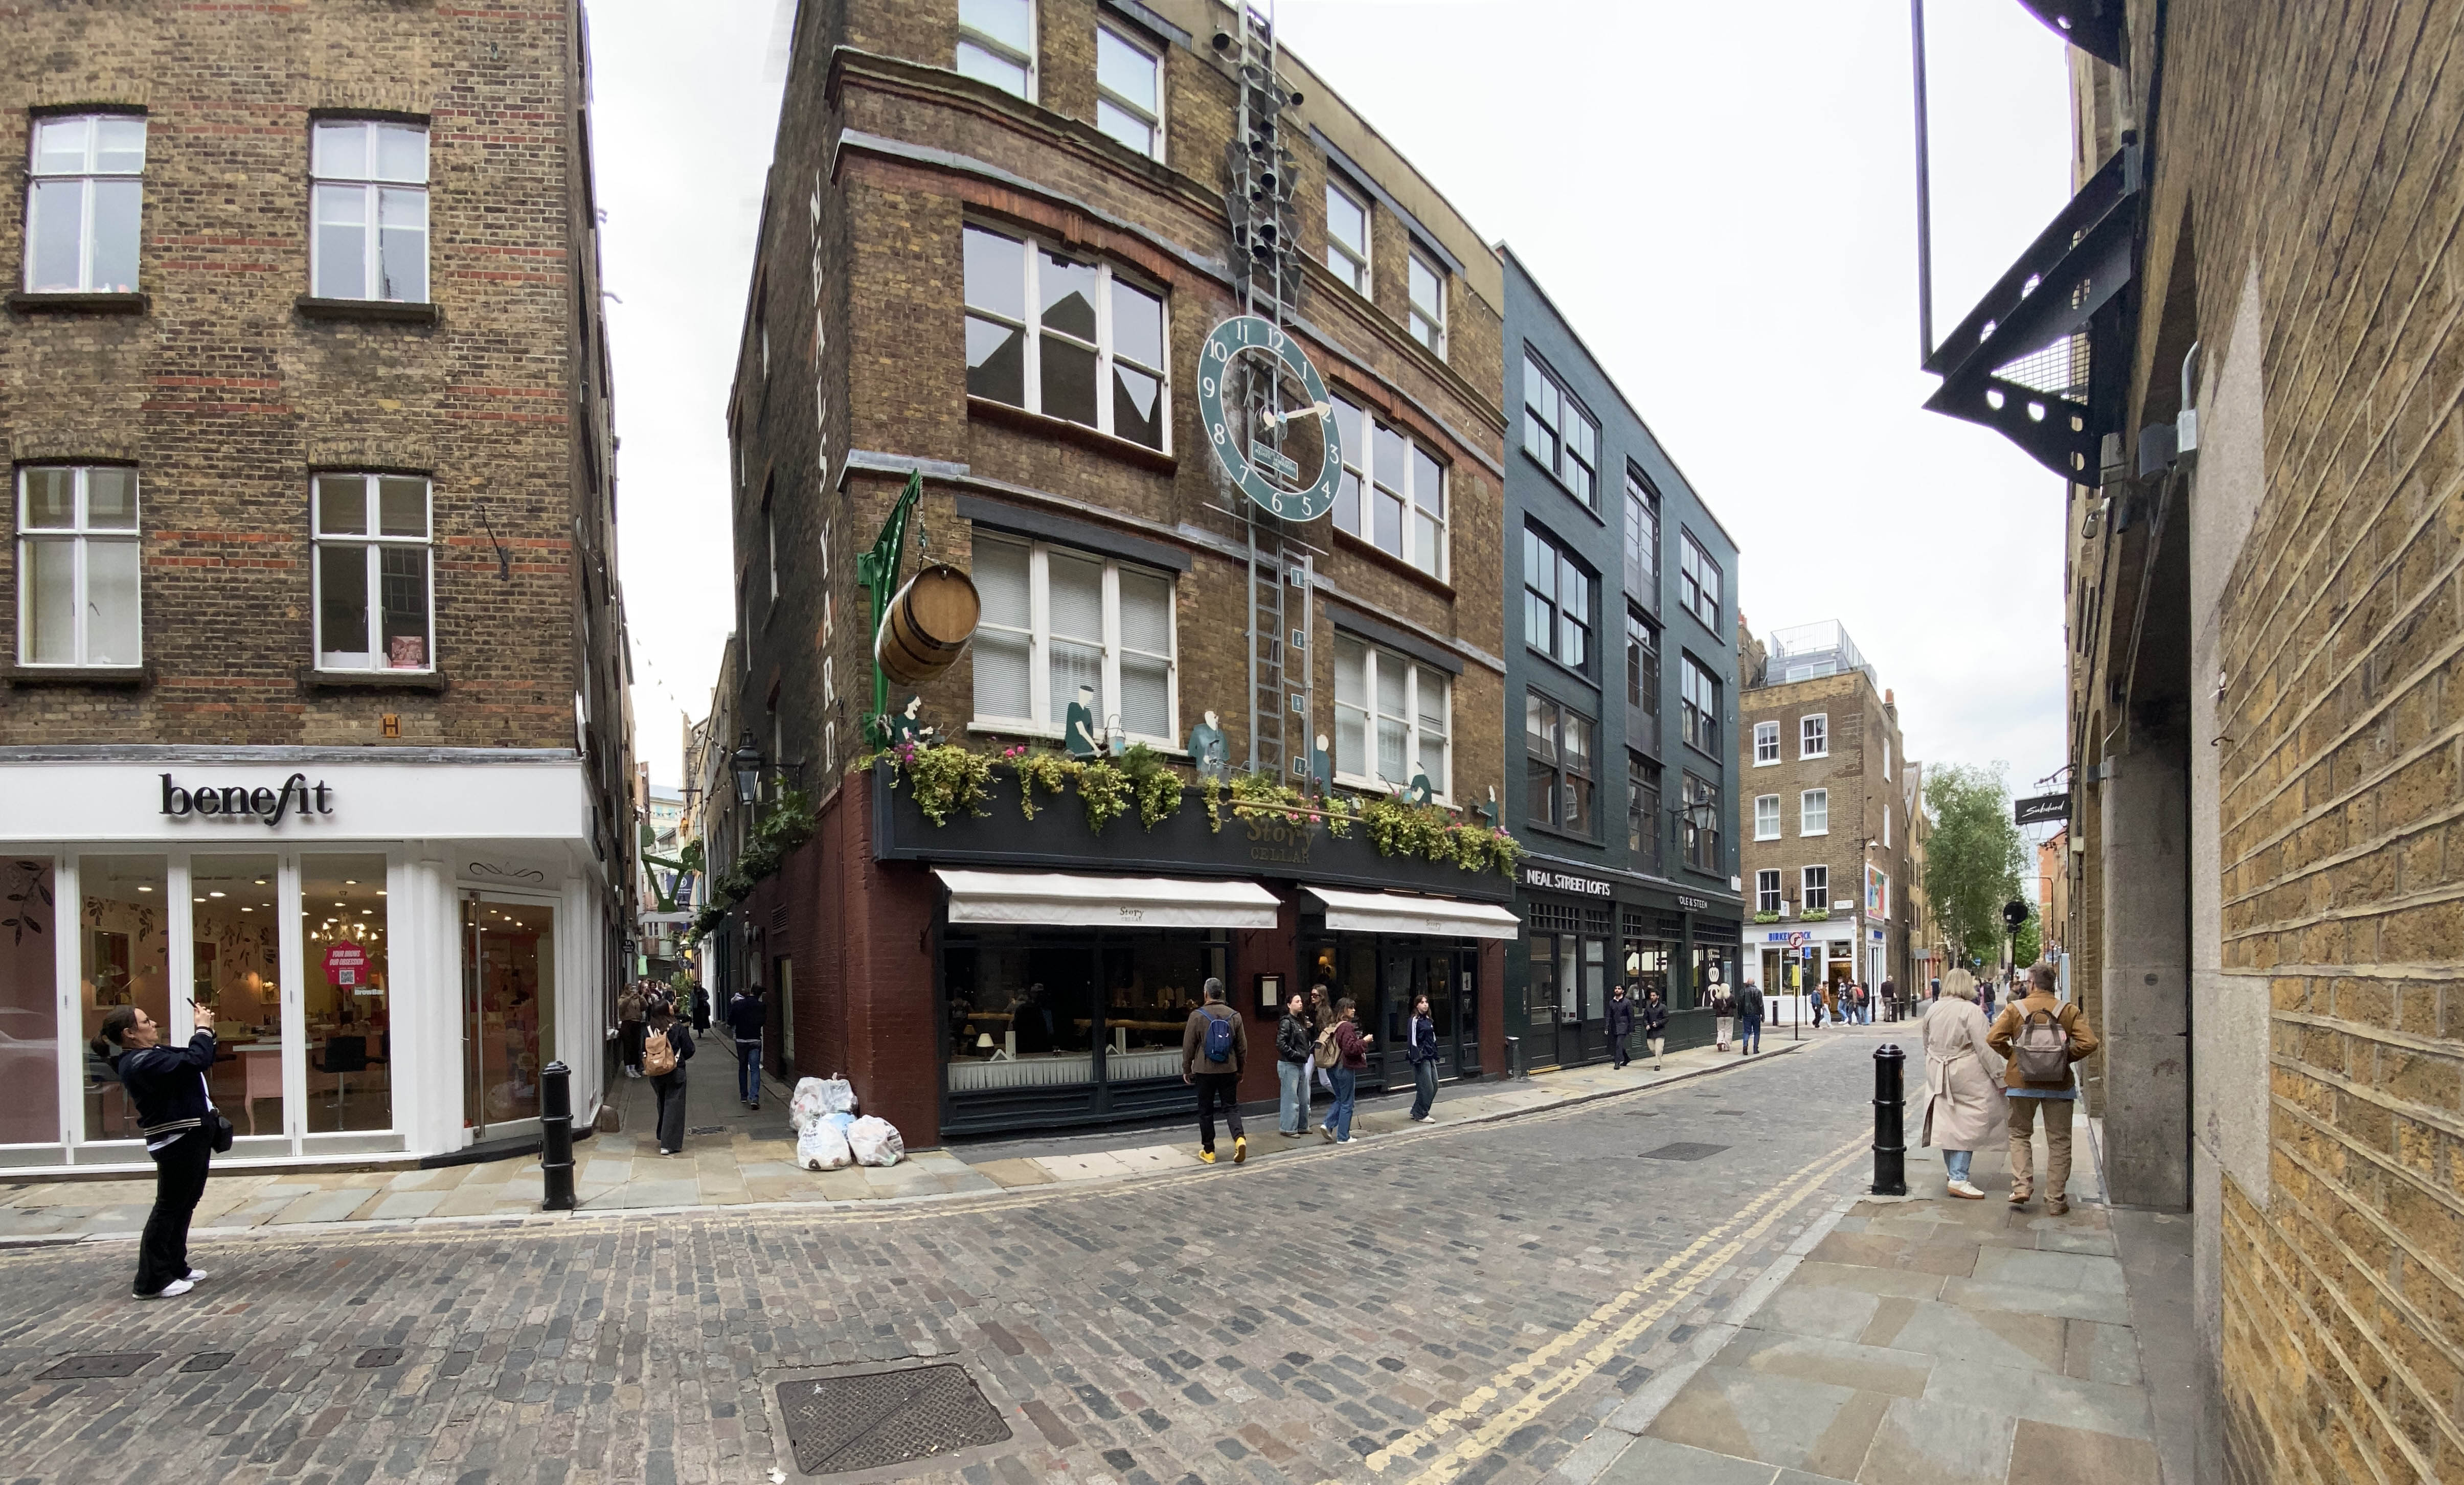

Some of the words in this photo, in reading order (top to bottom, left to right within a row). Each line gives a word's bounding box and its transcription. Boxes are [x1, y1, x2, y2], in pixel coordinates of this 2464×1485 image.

[1236, 320, 1249, 344] 11
[1268, 328, 1284, 354] 12
[1210, 338, 1228, 362] 10
[1301, 361, 1309, 381] 1
[1203, 376, 1215, 398] 9
[1213, 423, 1225, 445] 8
[1329, 443, 1339, 464] 3
[1239, 464, 1250, 486] 7
[1321, 481, 1331, 499] 4
[1272, 492, 1282, 513] 6
[1302, 496, 1312, 516] 5
[383, 717, 398, 734] H
[158, 772, 334, 827] benefit
[2021, 799, 2065, 817] Subdued
[1247, 818, 1316, 853] Story
[1251, 847, 1309, 864] CELLAR
[1527, 869, 1553, 887] NEAL
[1554, 874, 1586, 892] STREET
[1587, 880, 1610, 896] LOFTS
[1120, 906, 1144, 919] Story
[1679, 896, 1688, 905] OLE
[1689, 898, 1693, 906] &
[1693, 899, 1708, 908] STEEN
